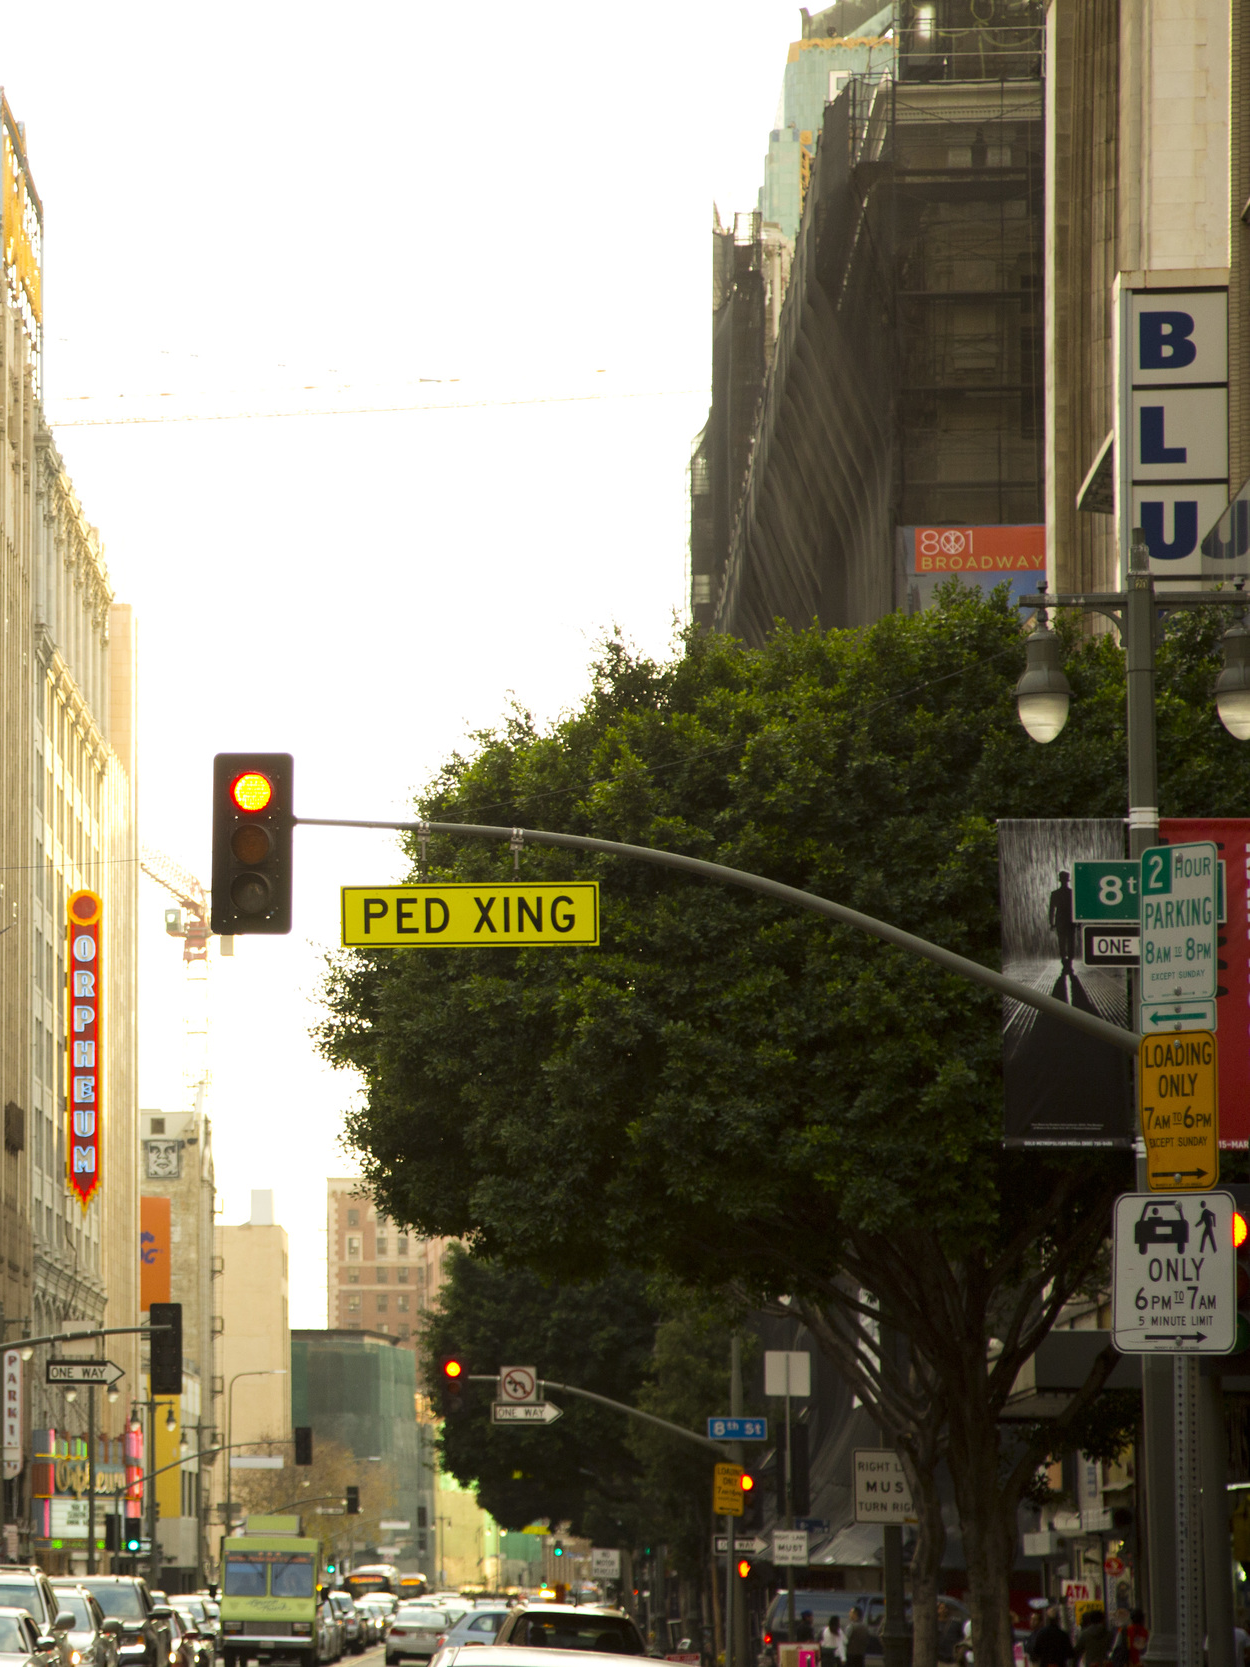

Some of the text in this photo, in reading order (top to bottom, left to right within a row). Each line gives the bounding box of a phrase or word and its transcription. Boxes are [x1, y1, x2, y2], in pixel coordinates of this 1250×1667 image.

[1139, 311, 1198, 564] BLU
[921, 530, 975, 555] 801
[921, 555, 1044, 570] BROADWAY
[1148, 855, 1212, 889] 2 HOUR
[1099, 875, 1138, 906] 8t
[363, 895, 576, 935] PED XING
[1145, 897, 1212, 931] PARKING
[1097, 938, 1132, 955] ONE
[1151, 969, 1206, 981] EXCEPT SUNDAY
[73, 935, 96, 1173] ORPHEUM
[1145, 1041, 1213, 1069] LOADING
[1158, 1073, 1198, 1098] ONLY
[1147, 1135, 1208, 1149] EXCEPT SUNDAY
[1149, 1257, 1205, 1282] ONLY
[1138, 1315, 1214, 1327] 5 MINUTE LIMIT
[51, 1367, 106, 1379] ONE WAY
[7, 1355, 19, 1471] PARKI
[498, 1408, 545, 1418] ONE WAY
[713, 1420, 762, 1436] 8th St
[857, 1461, 890, 1472] RIGHT
[858, 1501, 888, 1512] TURN
